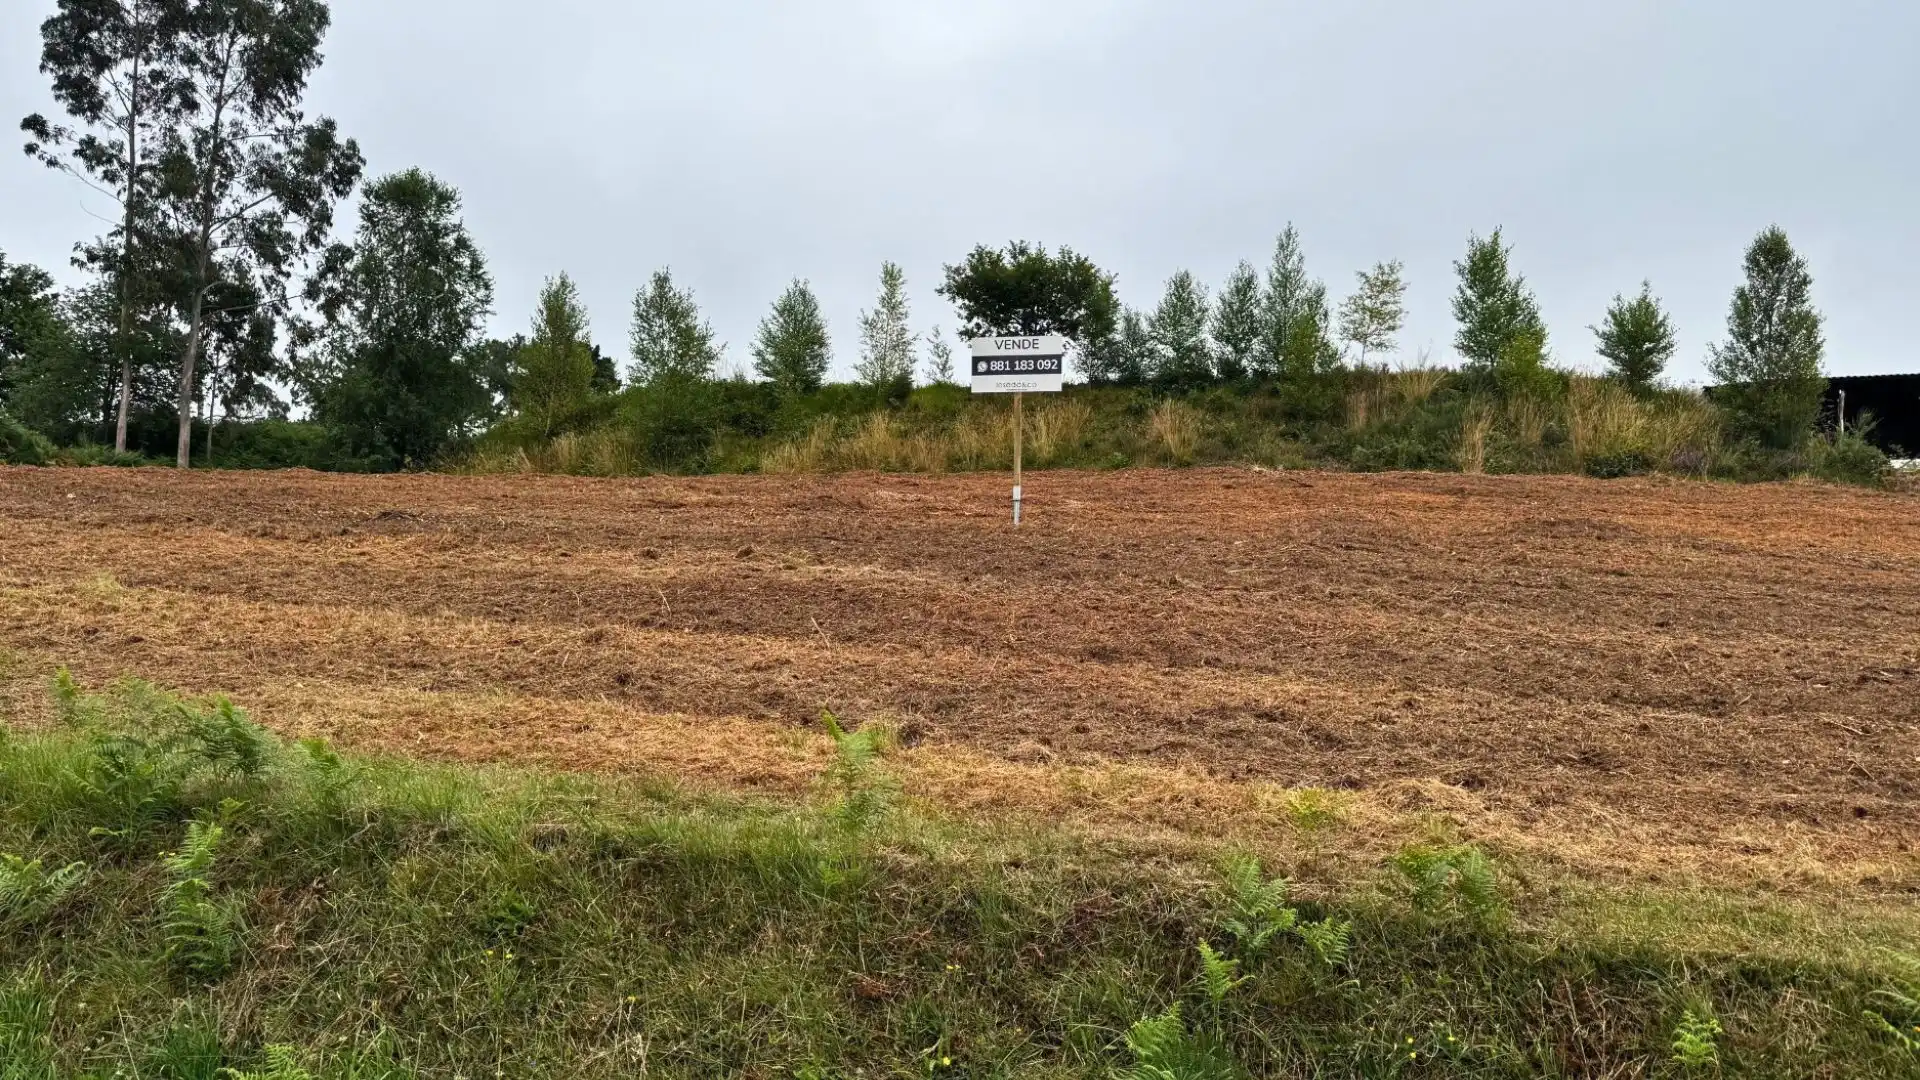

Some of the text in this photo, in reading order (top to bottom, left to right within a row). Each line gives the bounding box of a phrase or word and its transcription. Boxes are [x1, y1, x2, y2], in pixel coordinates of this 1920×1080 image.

[994, 338, 1039, 350] VENDE
[990, 359, 1058, 371] 881 183 092
